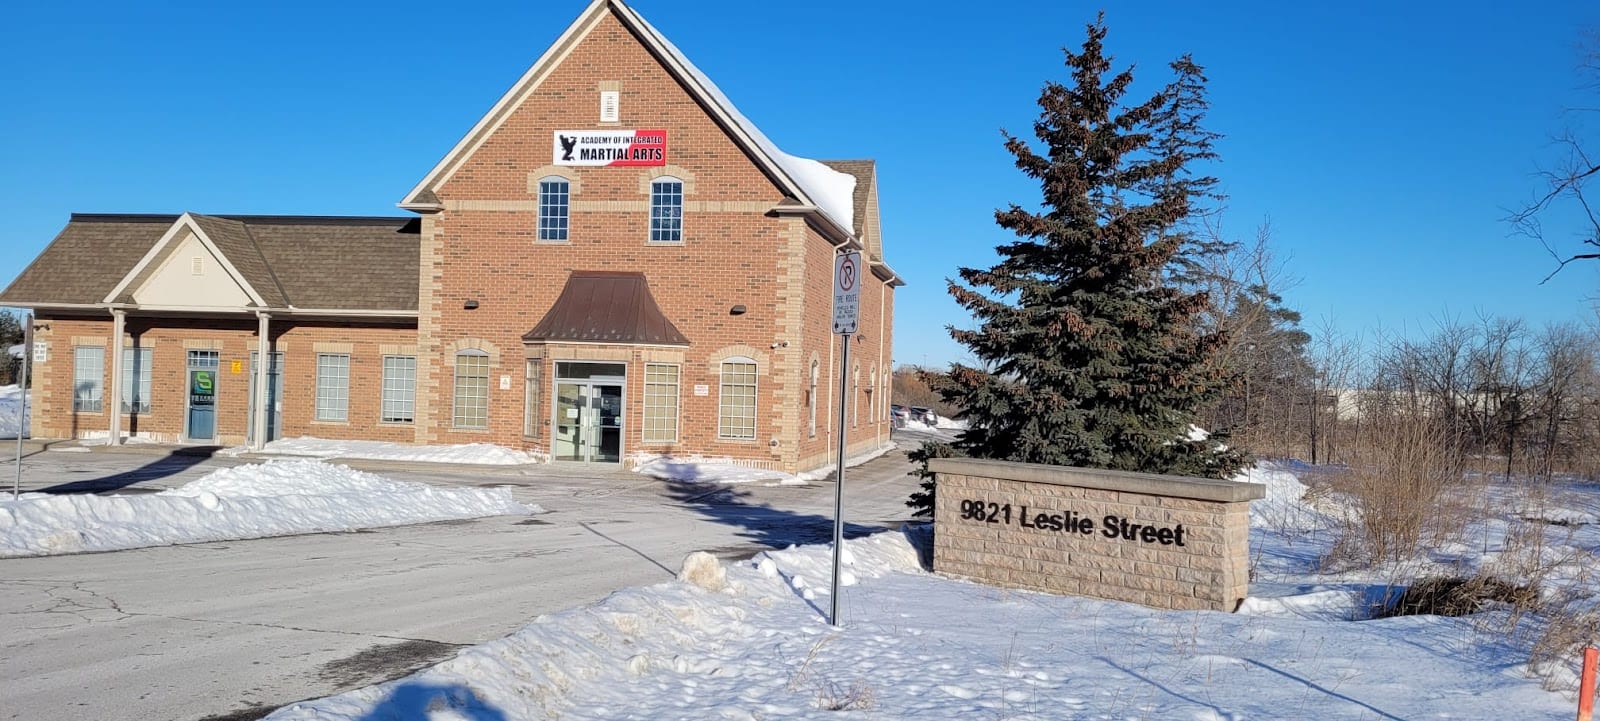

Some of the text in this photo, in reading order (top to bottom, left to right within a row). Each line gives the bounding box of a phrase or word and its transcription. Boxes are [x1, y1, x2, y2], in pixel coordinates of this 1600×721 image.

[580, 136, 662, 144] ACADEMY OF INTEGRATED
[580, 148, 662, 160] MARTIAL ARTS
[960, 500, 1185, 546] 9821 Leslie Street
